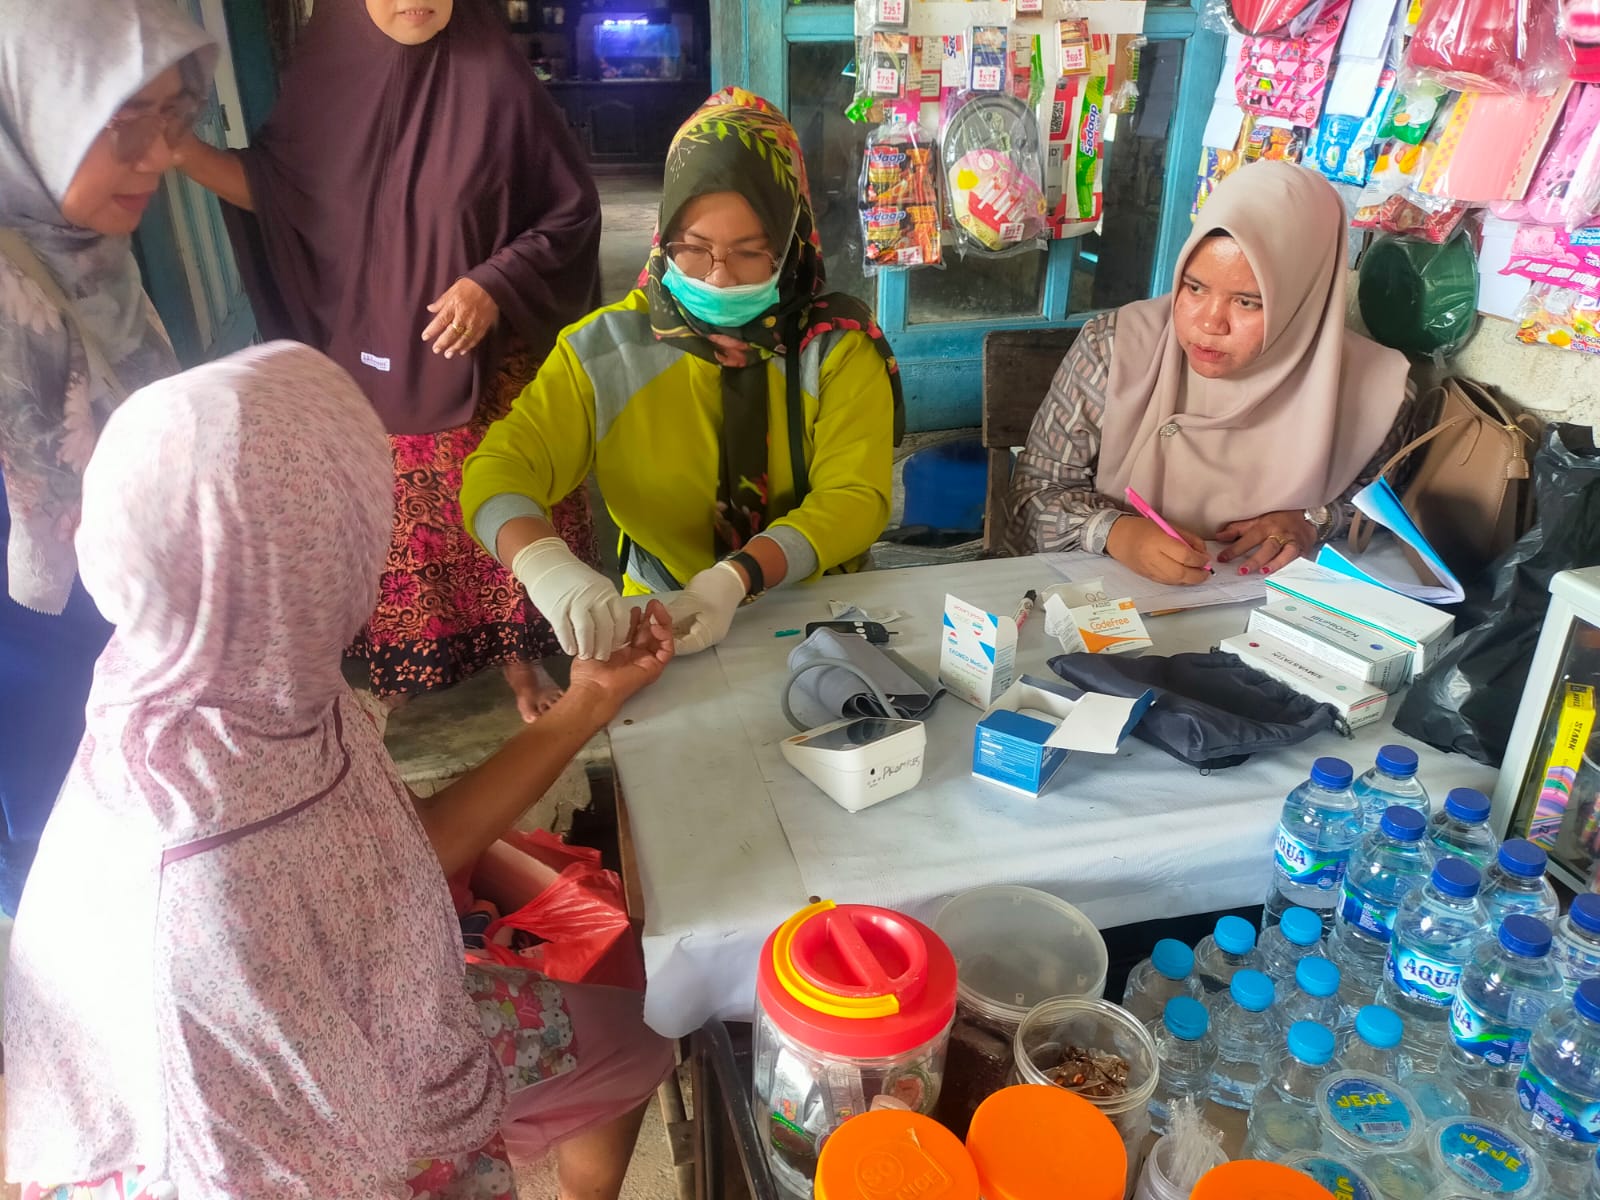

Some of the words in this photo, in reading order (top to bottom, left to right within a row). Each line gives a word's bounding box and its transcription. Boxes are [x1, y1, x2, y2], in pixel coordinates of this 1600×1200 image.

[1085, 104, 1098, 157] Sedaap
[1089, 616, 1130, 631] CodeFree
[1277, 834, 1307, 867] QUA
[1403, 957, 1461, 988] AQUA
[1336, 1093, 1392, 1109] JEJE
[1459, 1131, 1523, 1173] JEJE
